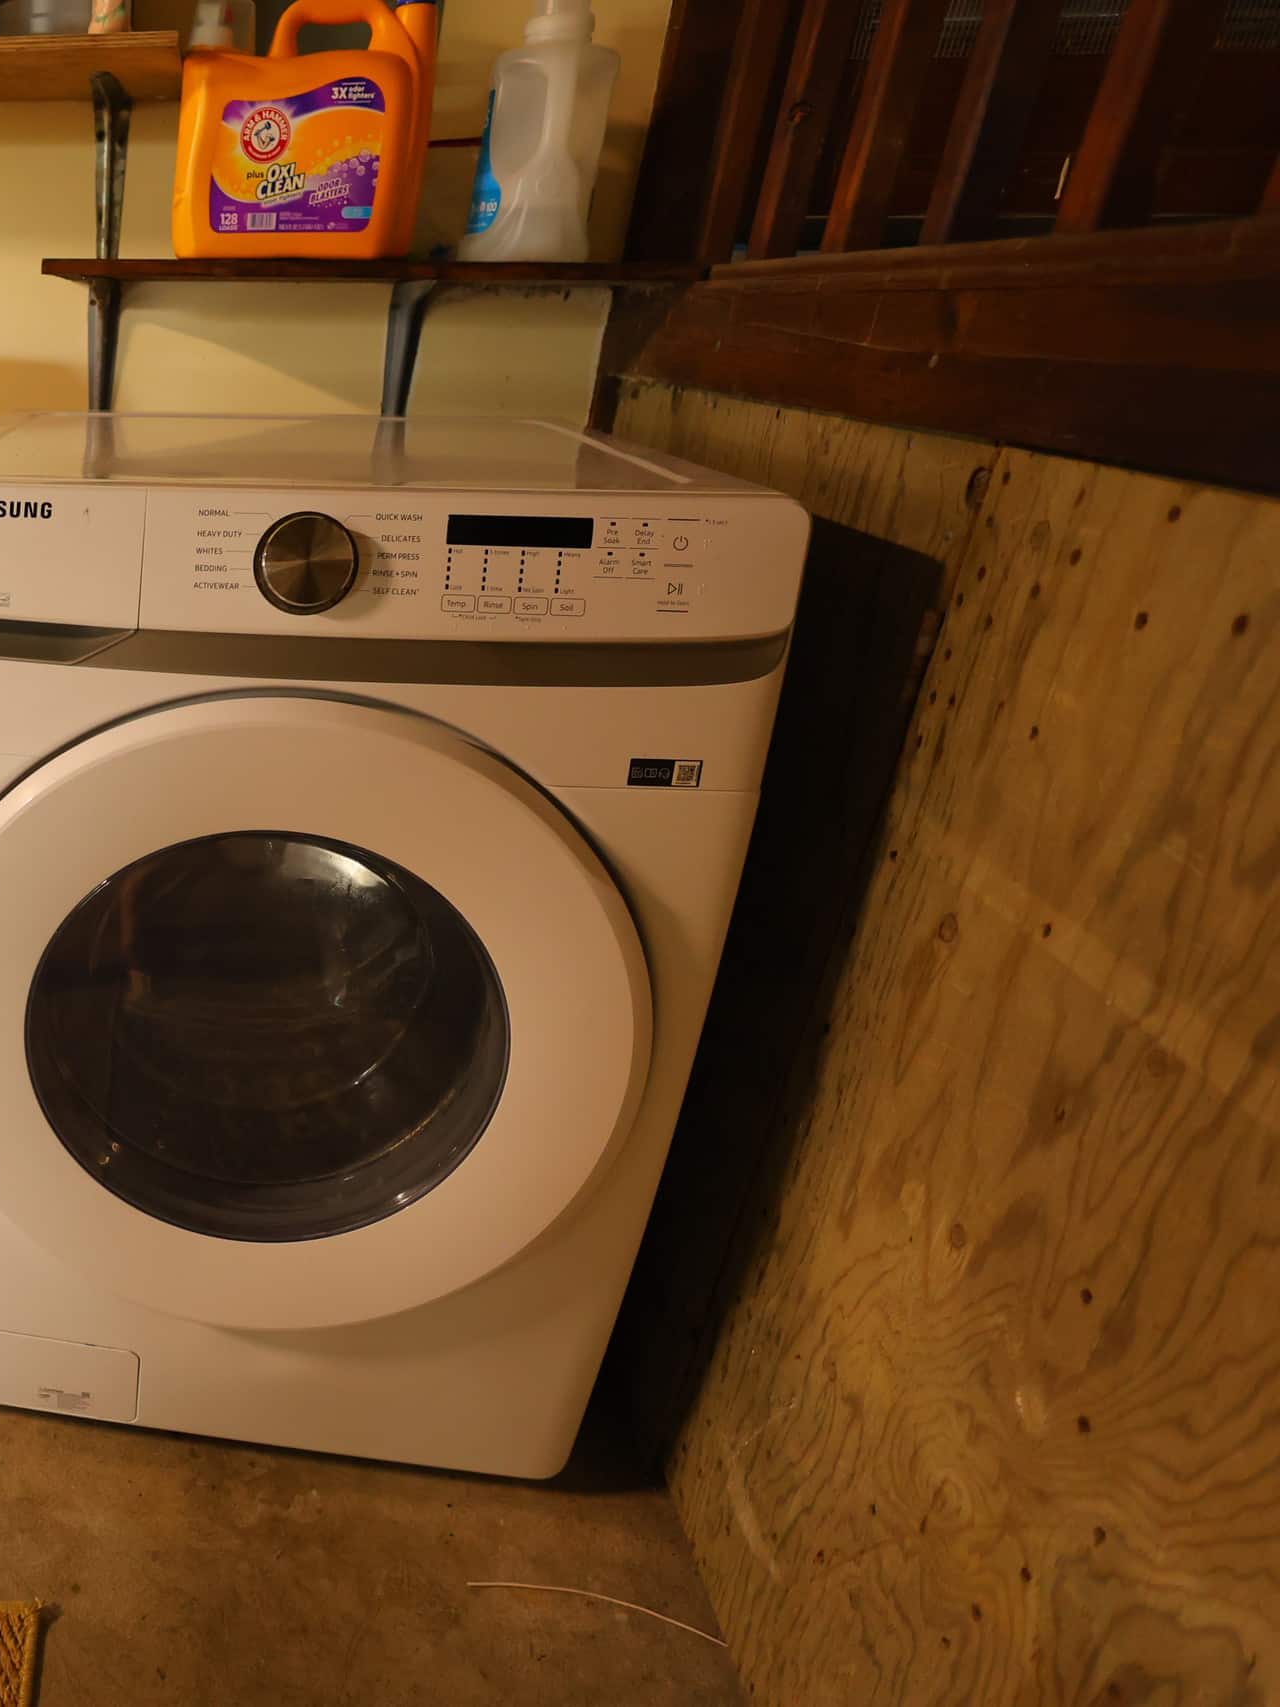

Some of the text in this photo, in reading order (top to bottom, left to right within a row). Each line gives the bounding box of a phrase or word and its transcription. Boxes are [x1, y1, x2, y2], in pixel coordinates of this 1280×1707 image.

[331, 87, 348, 100] 3X
[262, 110, 288, 140] HAMMER
[247, 162, 296, 182] plus OXI
[256, 174, 305, 200] CLEAN
[220, 212, 238, 225] 128
[198, 509, 230, 517] NORMAL
[375, 513, 423, 521] QUICK WASH
[197, 529, 242, 538] HEAVY DUTY
[634, 529, 655, 538] Delay
[381, 534, 421, 543] DELICATES
[637, 537, 651, 545] End
[195, 547, 223, 555] WHITES
[377, 552, 420, 561] PERM PRESS
[632, 558, 652, 566] Smart
[194, 564, 228, 572] BEDDING
[632, 567, 649, 575] Care
[372, 569, 394, 577] RINSE
[193, 582, 240, 590] ACTIVEWEAR
[373, 587, 391, 595] SELF
[447, 599, 467, 609] Temp
[483, 601, 503, 609] Rinse
[522, 602, 538, 612] Spin
[560, 603, 575, 612] Soil
